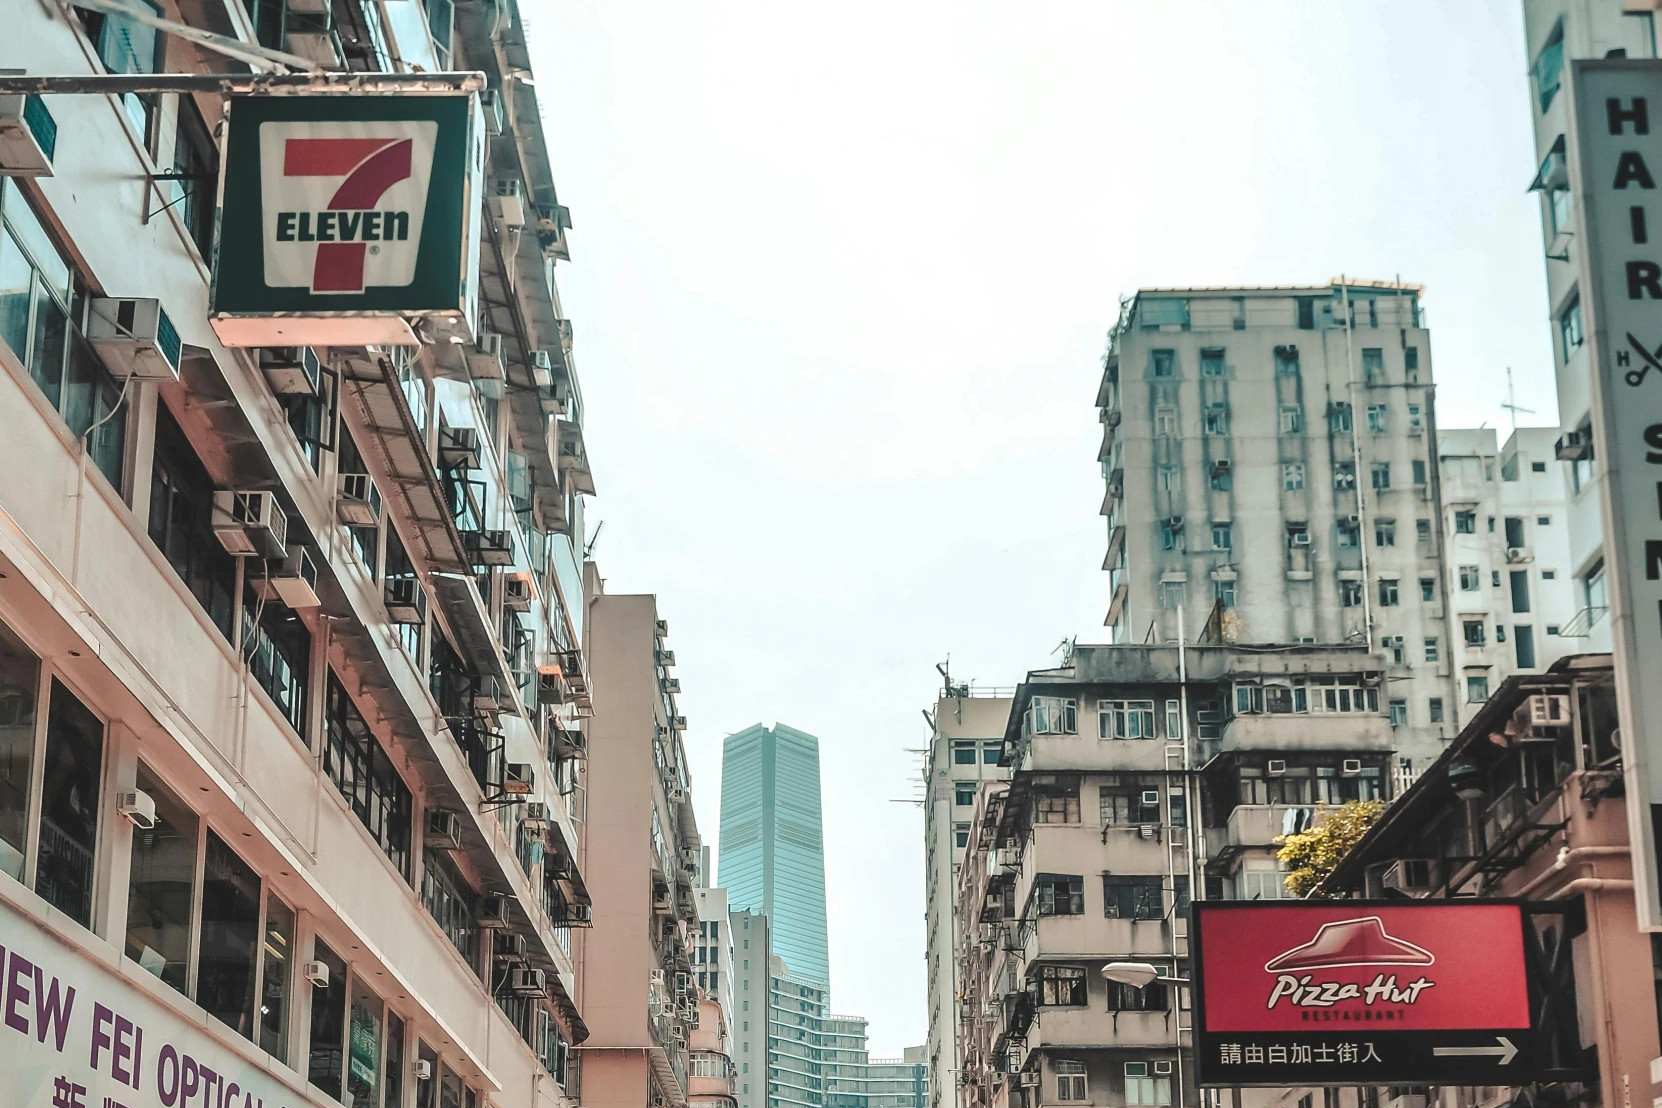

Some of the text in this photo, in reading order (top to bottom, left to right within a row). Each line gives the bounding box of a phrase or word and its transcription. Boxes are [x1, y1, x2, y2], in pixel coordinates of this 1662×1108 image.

[284, 138, 413, 291] 7
[1605, 97, 1662, 300] HAIR
[0, 944, 77, 1053] EW
[90, 1001, 143, 1091] FEI
[1266, 973, 1435, 1009] Pizza Hut
[1302, 1010, 1405, 1021] RESTAURANT
[1219, 1042, 1383, 1065] 請由白加士街入
